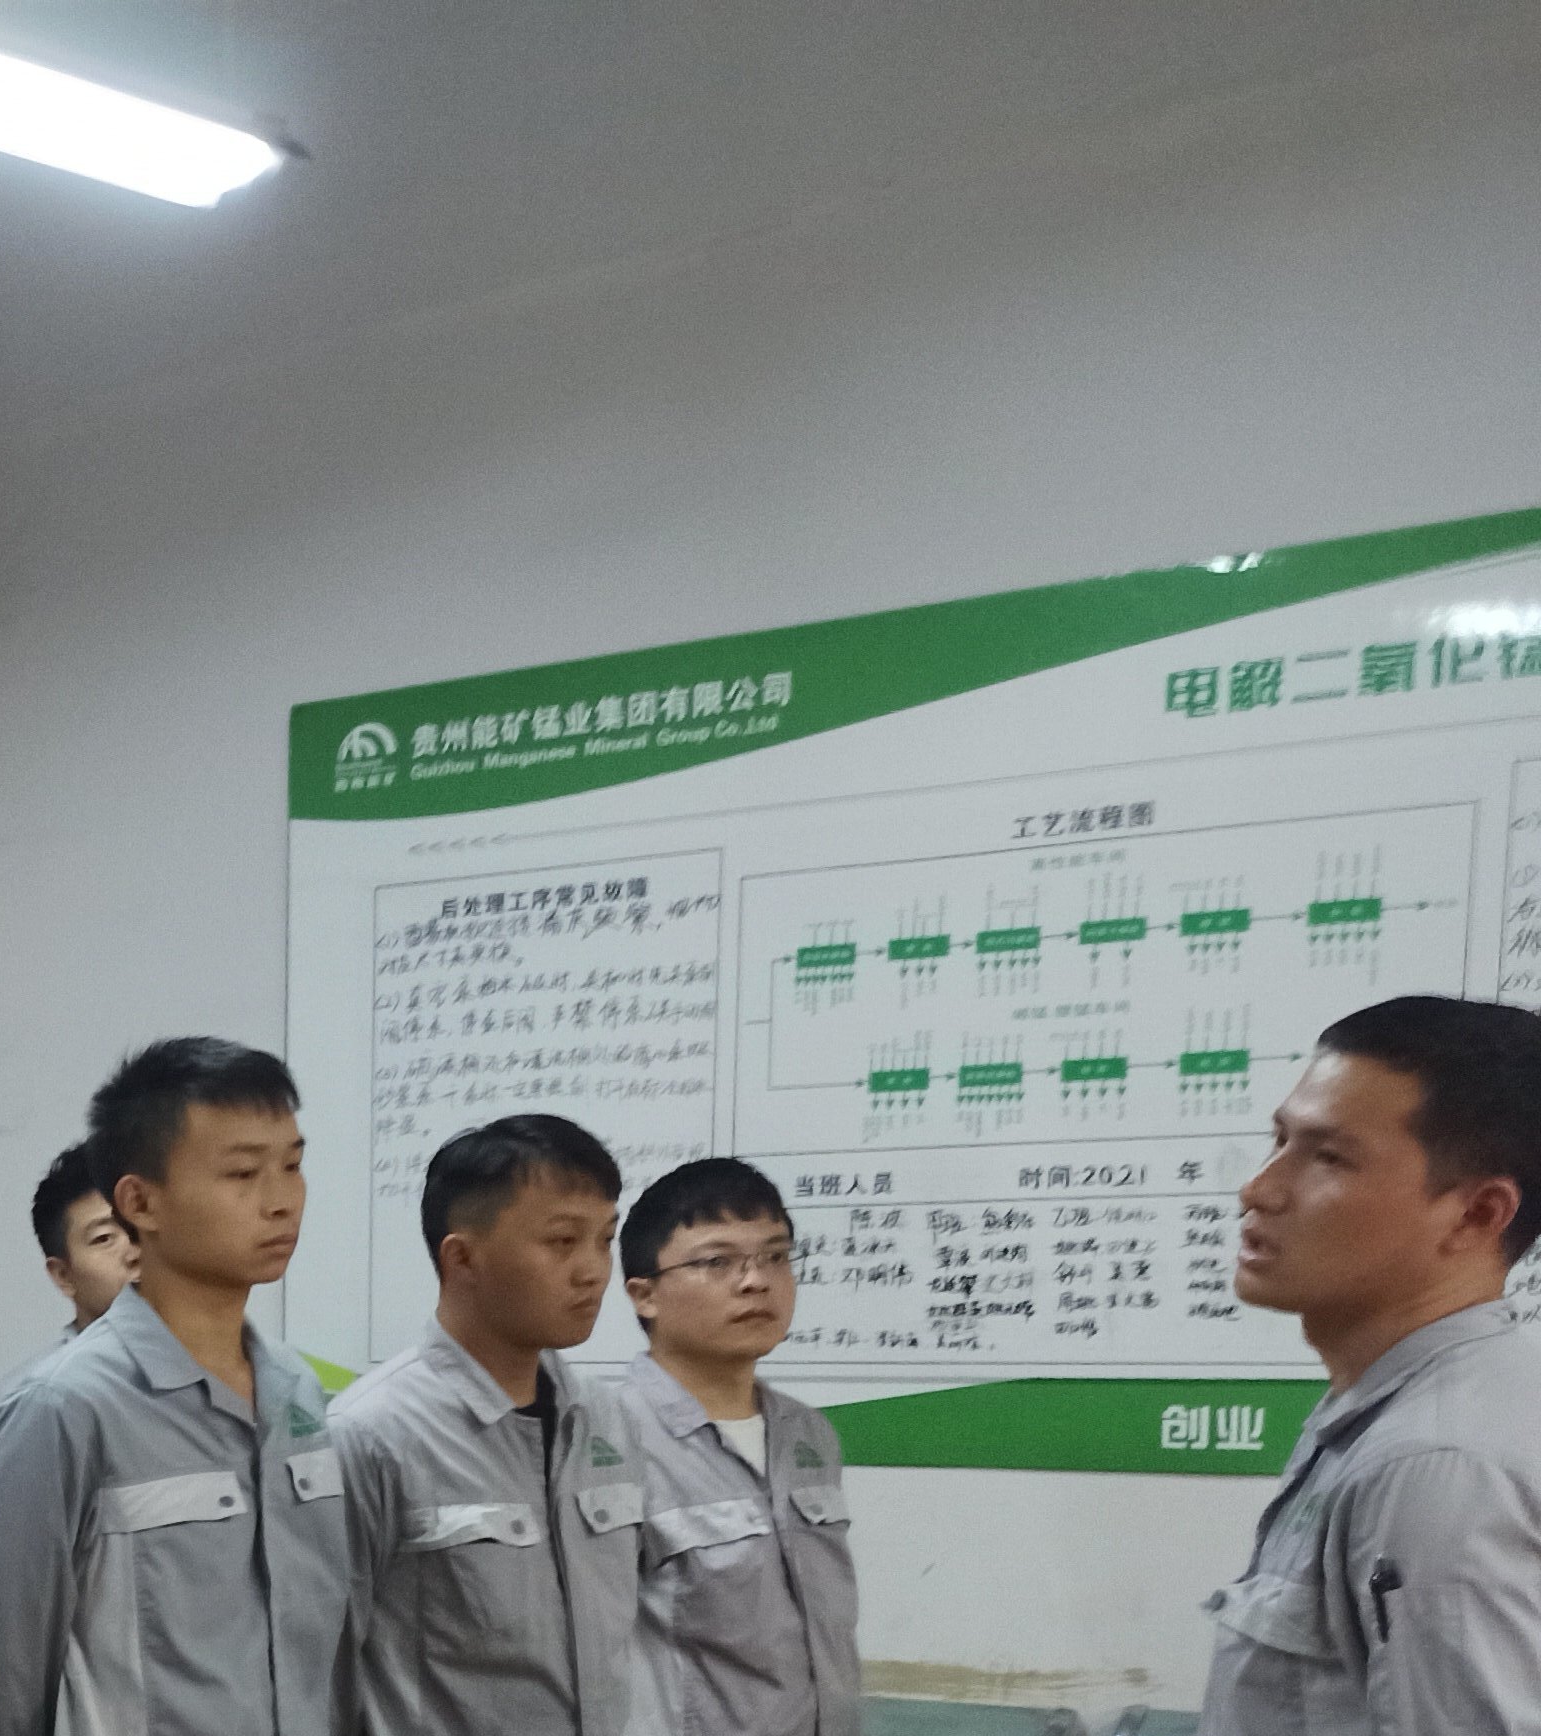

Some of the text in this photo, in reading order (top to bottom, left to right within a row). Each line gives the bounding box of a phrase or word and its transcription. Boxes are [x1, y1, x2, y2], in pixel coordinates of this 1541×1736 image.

[411, 671, 793, 758] 贵州能矿锰业集团有限公司
[410, 760, 476, 780] Guizhou
[483, 745, 577, 769] Manganese
[584, 731, 648, 756] Mineral
[656, 726, 711, 746] Group
[1011, 801, 1156, 840] 工艺流程图
[794, 1171, 893, 1198] 当班人员
[1176, 1160, 1205, 1185] 年
[1160, 1404, 1266, 1451] 创业
